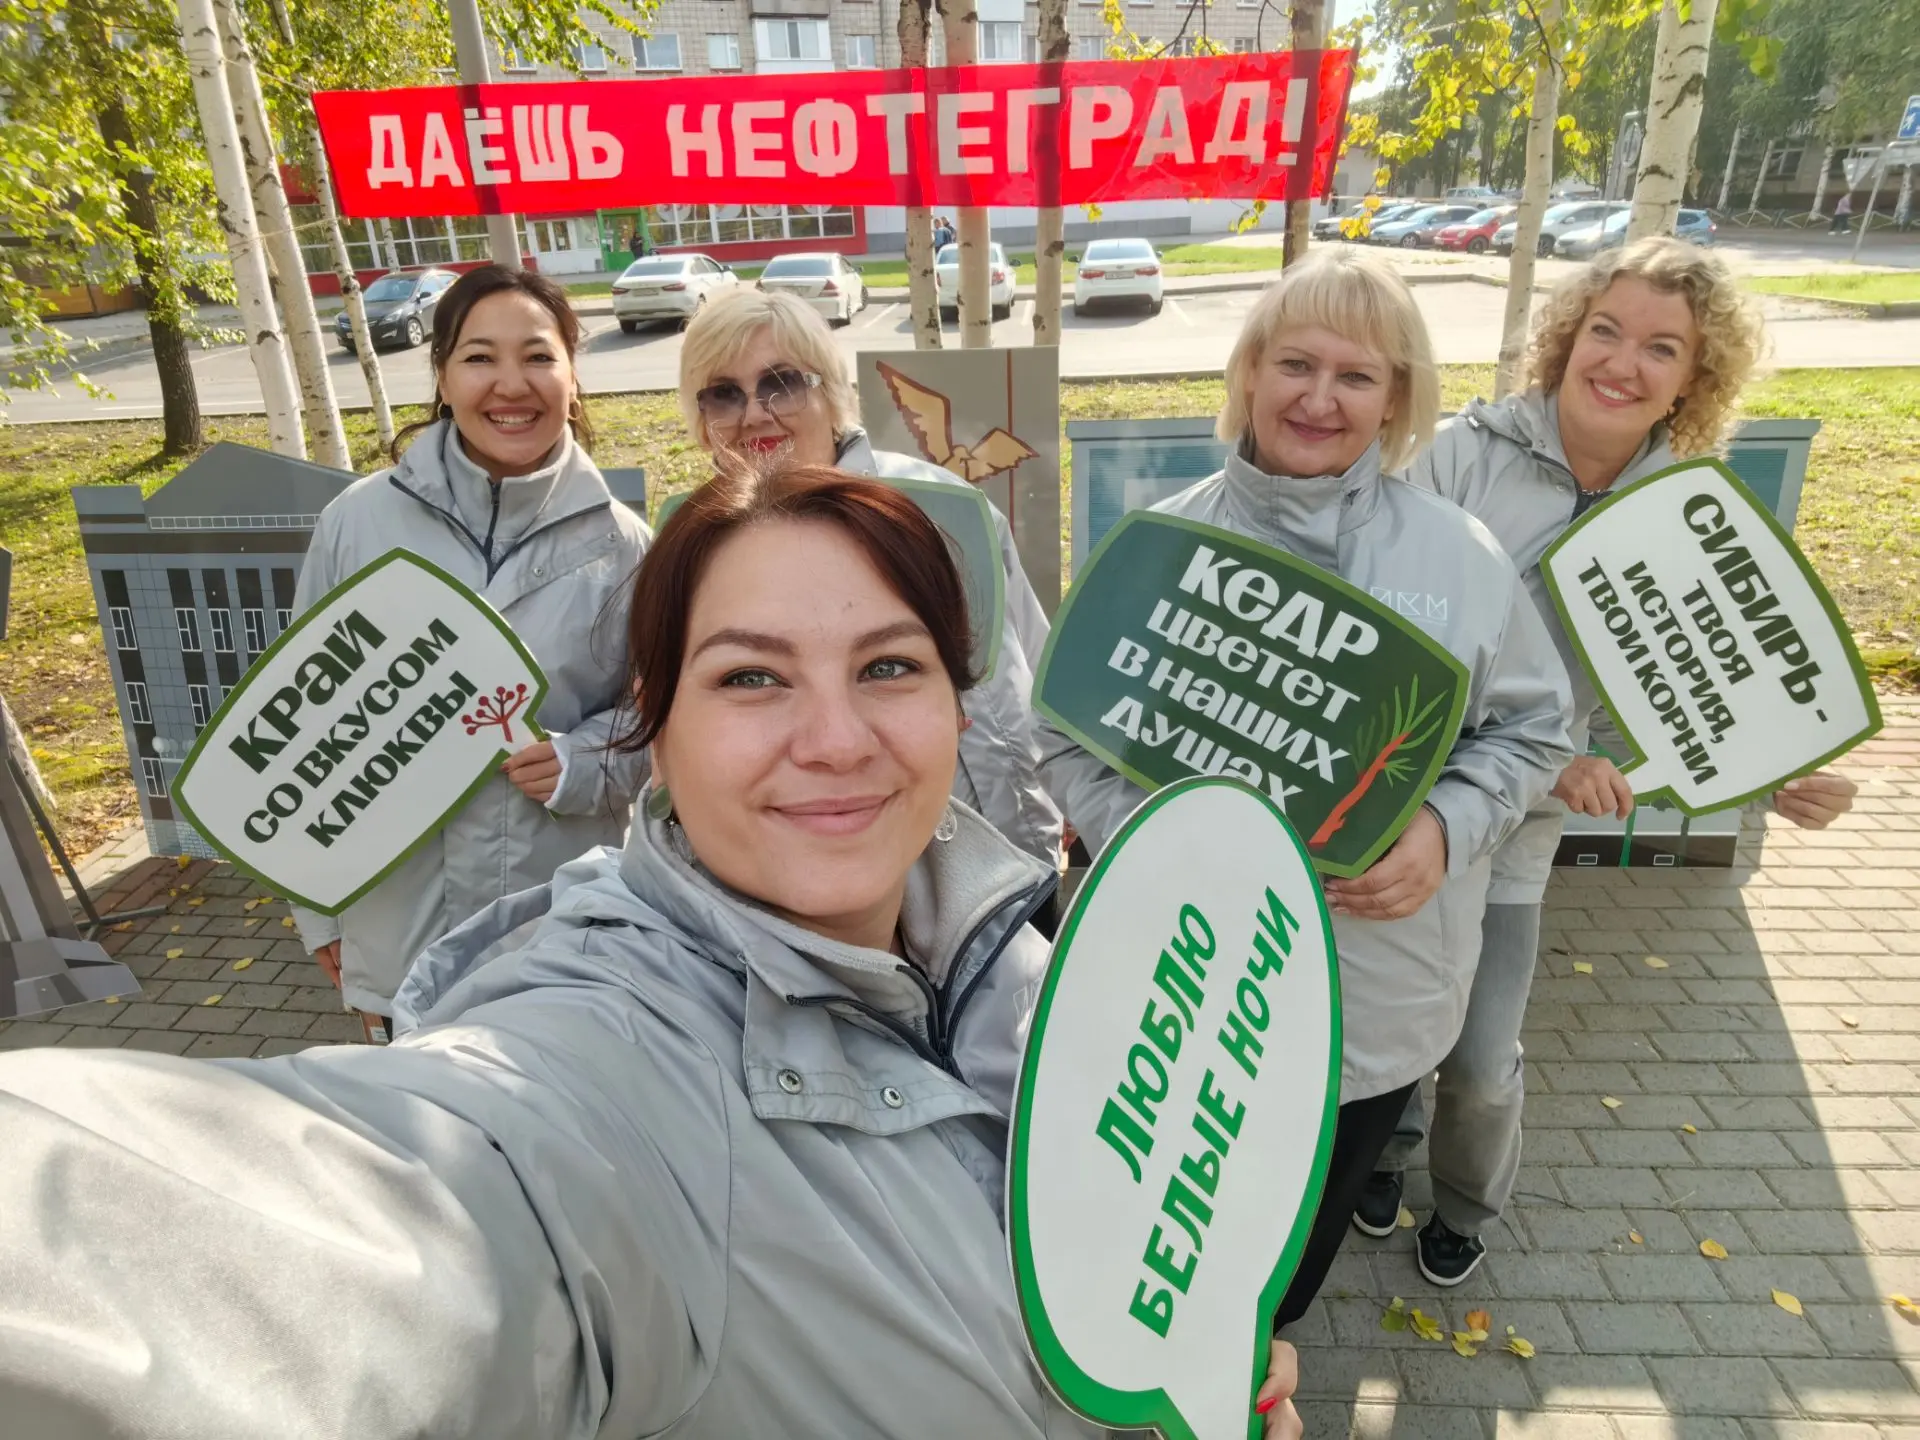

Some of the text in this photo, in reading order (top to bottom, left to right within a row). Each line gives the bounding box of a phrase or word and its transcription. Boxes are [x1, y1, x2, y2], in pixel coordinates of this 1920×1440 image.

[367, 78, 1308, 189] ДАЁШЬ НЕФТЕГРАД!
[244, 618, 459, 843] СО ВКУСОМ
[1578, 557, 1719, 785] ТВОИ КОРНИ
[1622, 560, 1736, 744] ИСТОРИЯ,
[1682, 579, 1754, 685] ТВОЯ
[305, 670, 478, 848] КЛЮКВЫ
[1096, 903, 1216, 1184] ЛЮБЛЮ
[1128, 885, 1300, 1339] БЕЛЫЕ НОЧИ
